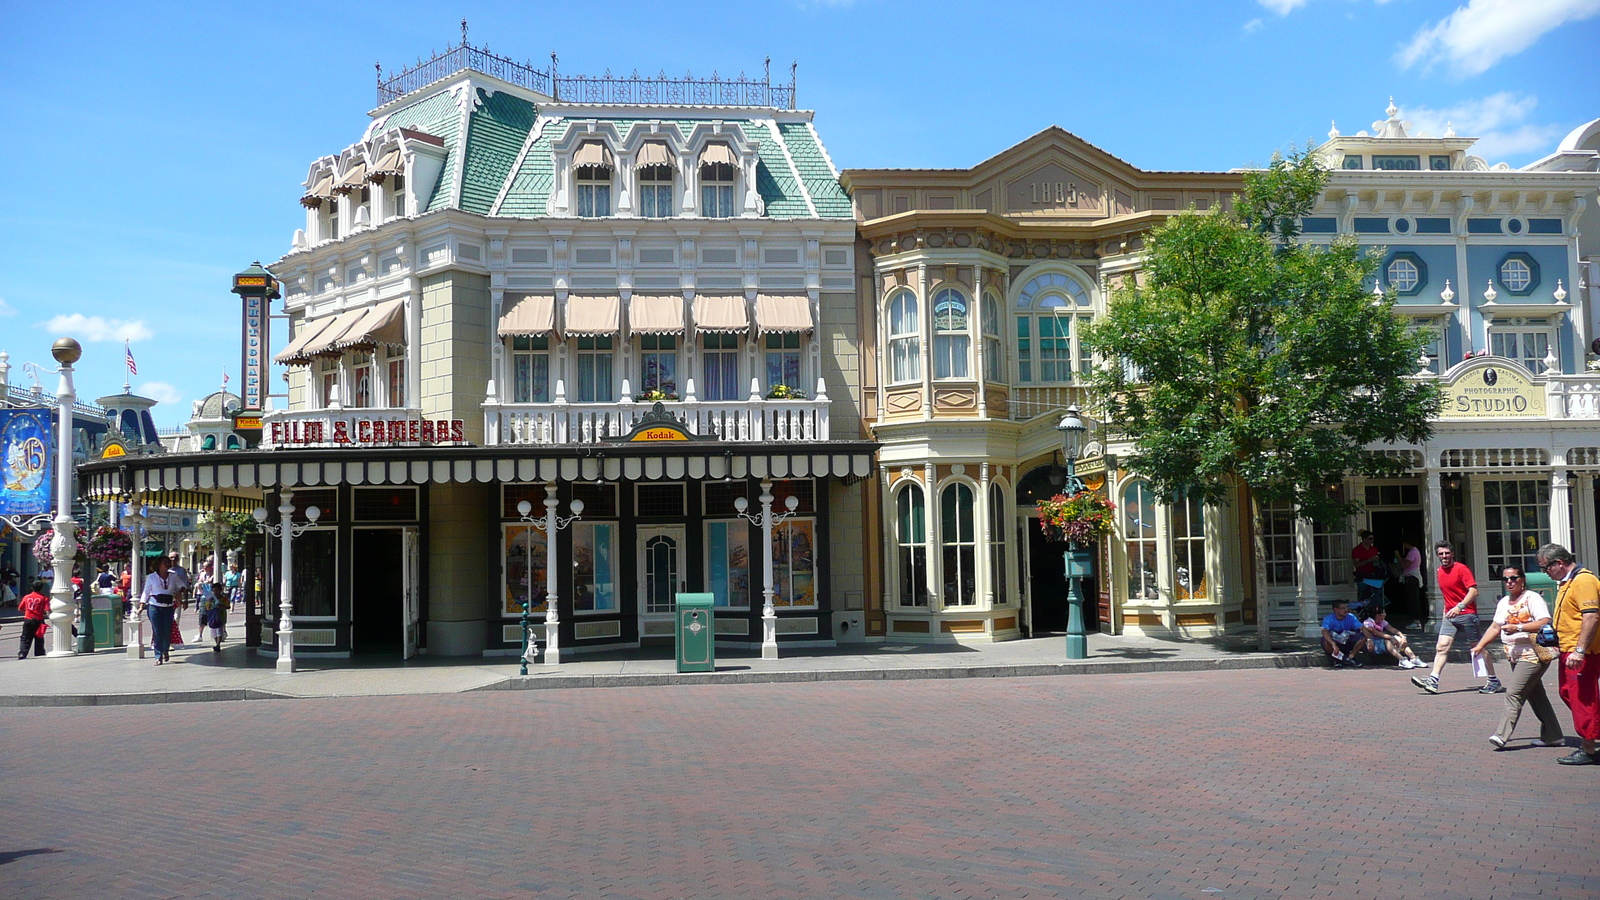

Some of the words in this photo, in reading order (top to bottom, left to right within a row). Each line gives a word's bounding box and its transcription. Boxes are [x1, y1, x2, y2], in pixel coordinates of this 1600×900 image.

[1378, 159, 1416, 170] 1900
[1030, 182, 1077, 203] 1885
[248, 299, 259, 406] PHOTOGRAPHY
[1460, 370, 1481, 384] GEORGE
[1498, 369, 1523, 385] EASTMAN
[1456, 395, 1527, 412] STUDIO
[271, 421, 323, 445] FILM
[333, 421, 355, 445] &
[358, 419, 463, 445] CAMERAS
[647, 431, 674, 439] Kodak
